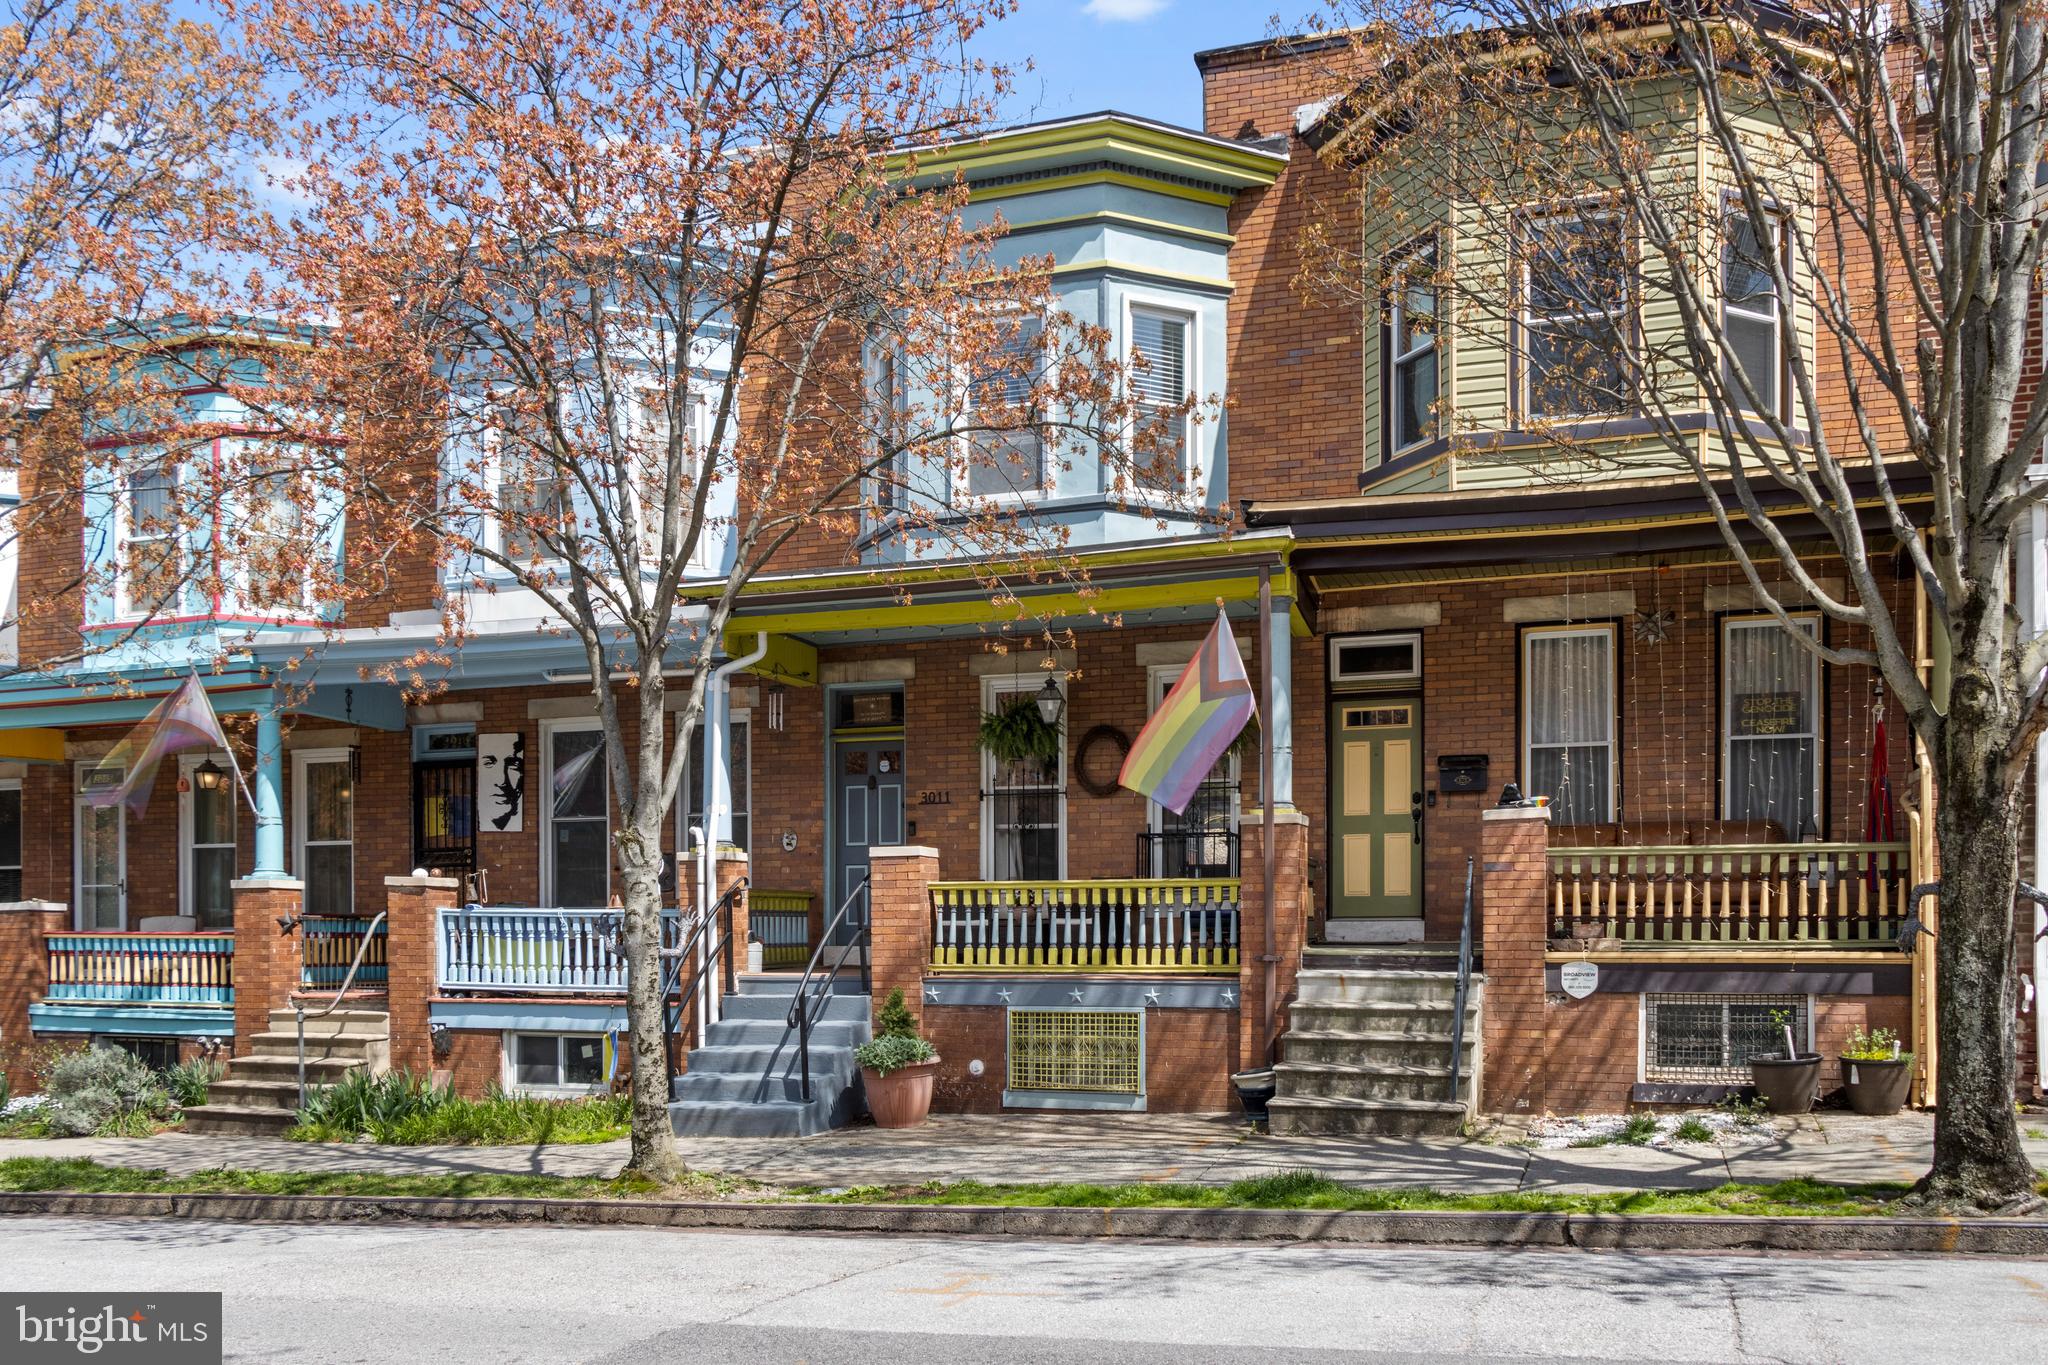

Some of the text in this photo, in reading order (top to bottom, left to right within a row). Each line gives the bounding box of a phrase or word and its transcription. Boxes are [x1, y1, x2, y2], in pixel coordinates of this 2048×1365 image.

[1743, 696, 1795, 706] STOP THE
[1742, 704, 1796, 713] GENOCIDE
[1741, 717, 1796, 727] CEASEFIRE
[920, 791, 950, 804] 3011
